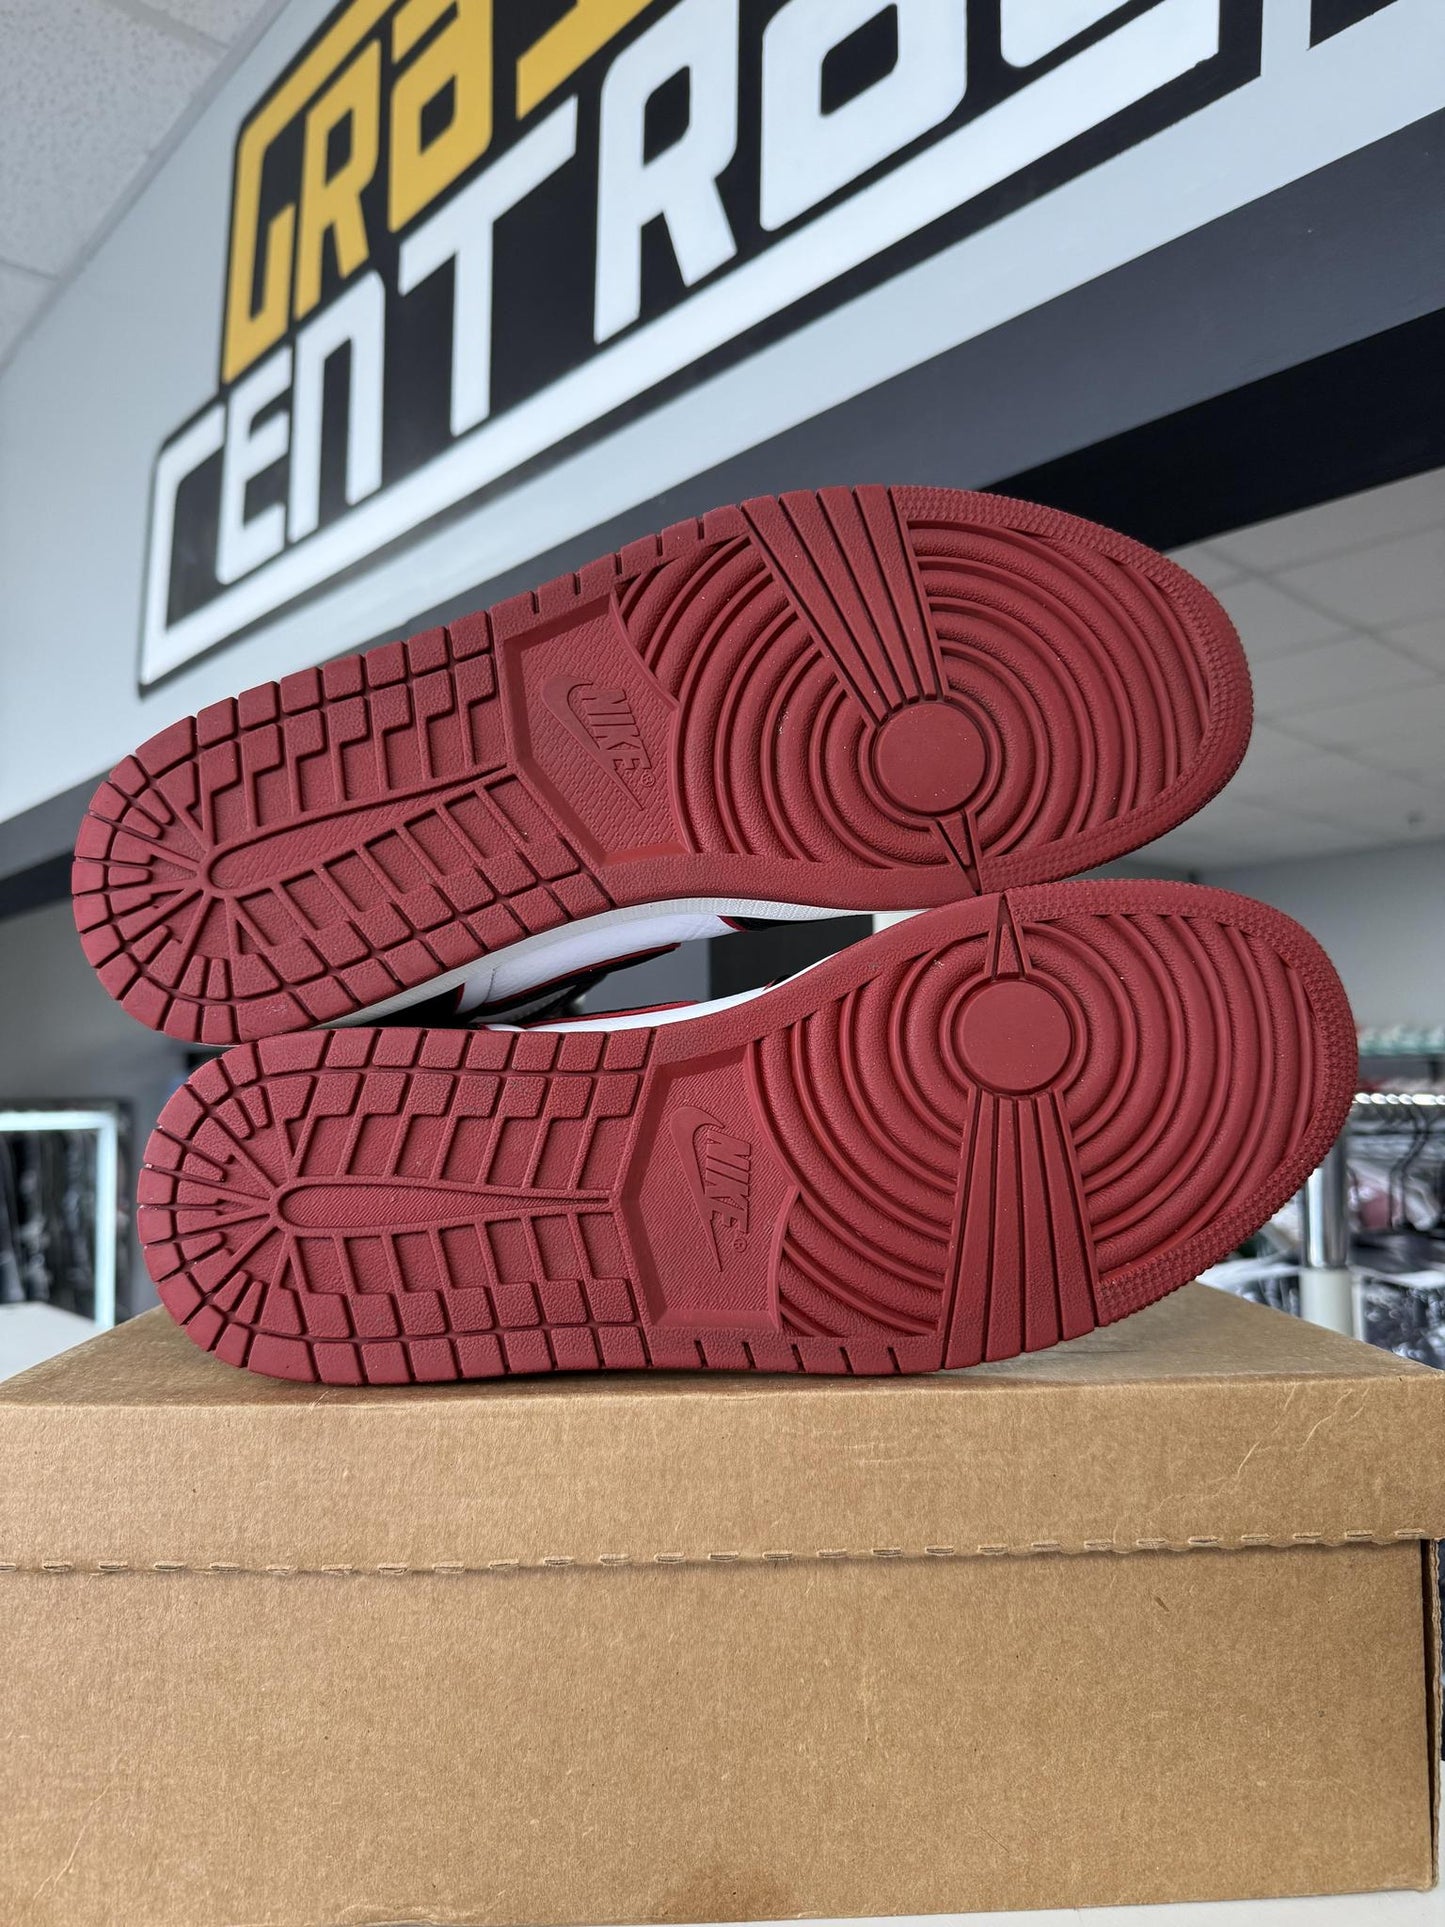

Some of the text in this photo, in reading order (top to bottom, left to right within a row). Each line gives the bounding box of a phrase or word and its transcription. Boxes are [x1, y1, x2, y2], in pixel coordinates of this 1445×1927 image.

[222, 0, 655, 385] GRA
[141, 0, 1219, 686] CENTRA
[577, 686, 653, 771] NIKE
[705, 1128, 752, 1235] NIKE
